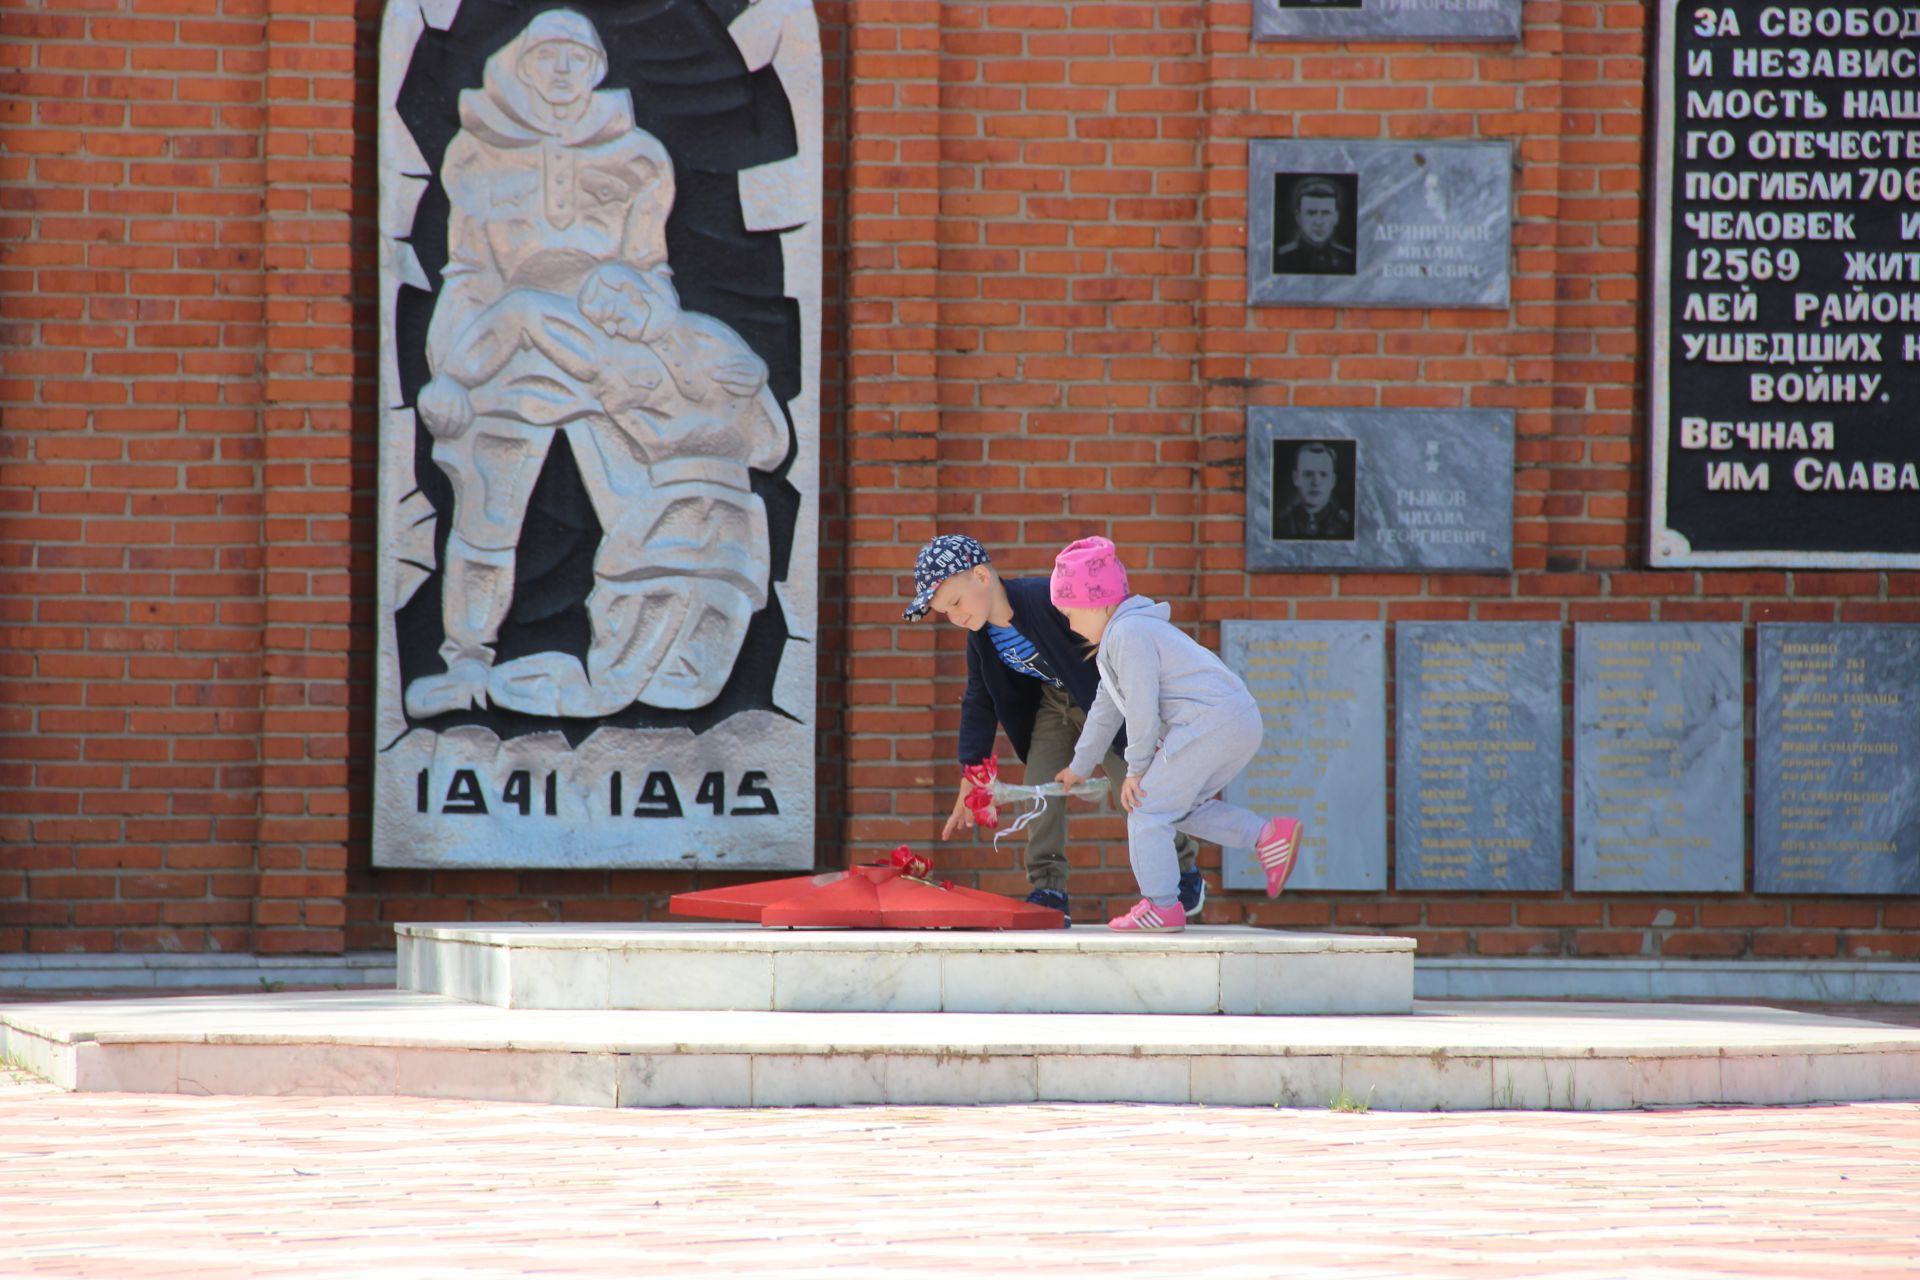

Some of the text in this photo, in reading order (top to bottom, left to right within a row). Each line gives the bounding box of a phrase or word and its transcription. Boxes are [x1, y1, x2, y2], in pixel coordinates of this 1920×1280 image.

[1693, 7, 1741, 37] ЗА
[1687, 48, 1920, 78] И НЕЗАВИС
[1687, 89, 1827, 119] МОСТЬ
[1687, 130, 1736, 159] ГО
[1685, 171, 1852, 201] ПОГИБЛИ
[1684, 211, 1856, 241] ЧЕЛОВЕК
[1397, 245, 1464, 260] МИХАИЛ
[1686, 247, 1800, 281] 12569
[1683, 284, 1920, 327] ЛЕЙ РАЙОН
[1681, 332, 1883, 365] УШЕДШИХ
[1750, 366, 1890, 403] ВОЙНУ.
[1706, 462, 1770, 491] ИМ
[1396, 489, 1467, 507] РЫЖОВ
[1397, 510, 1465, 525] МИХАИЛ
[1376, 528, 1487, 545] ГЕОРГИЕВИЧ
[417, 768, 780, 817] 1941 1945
